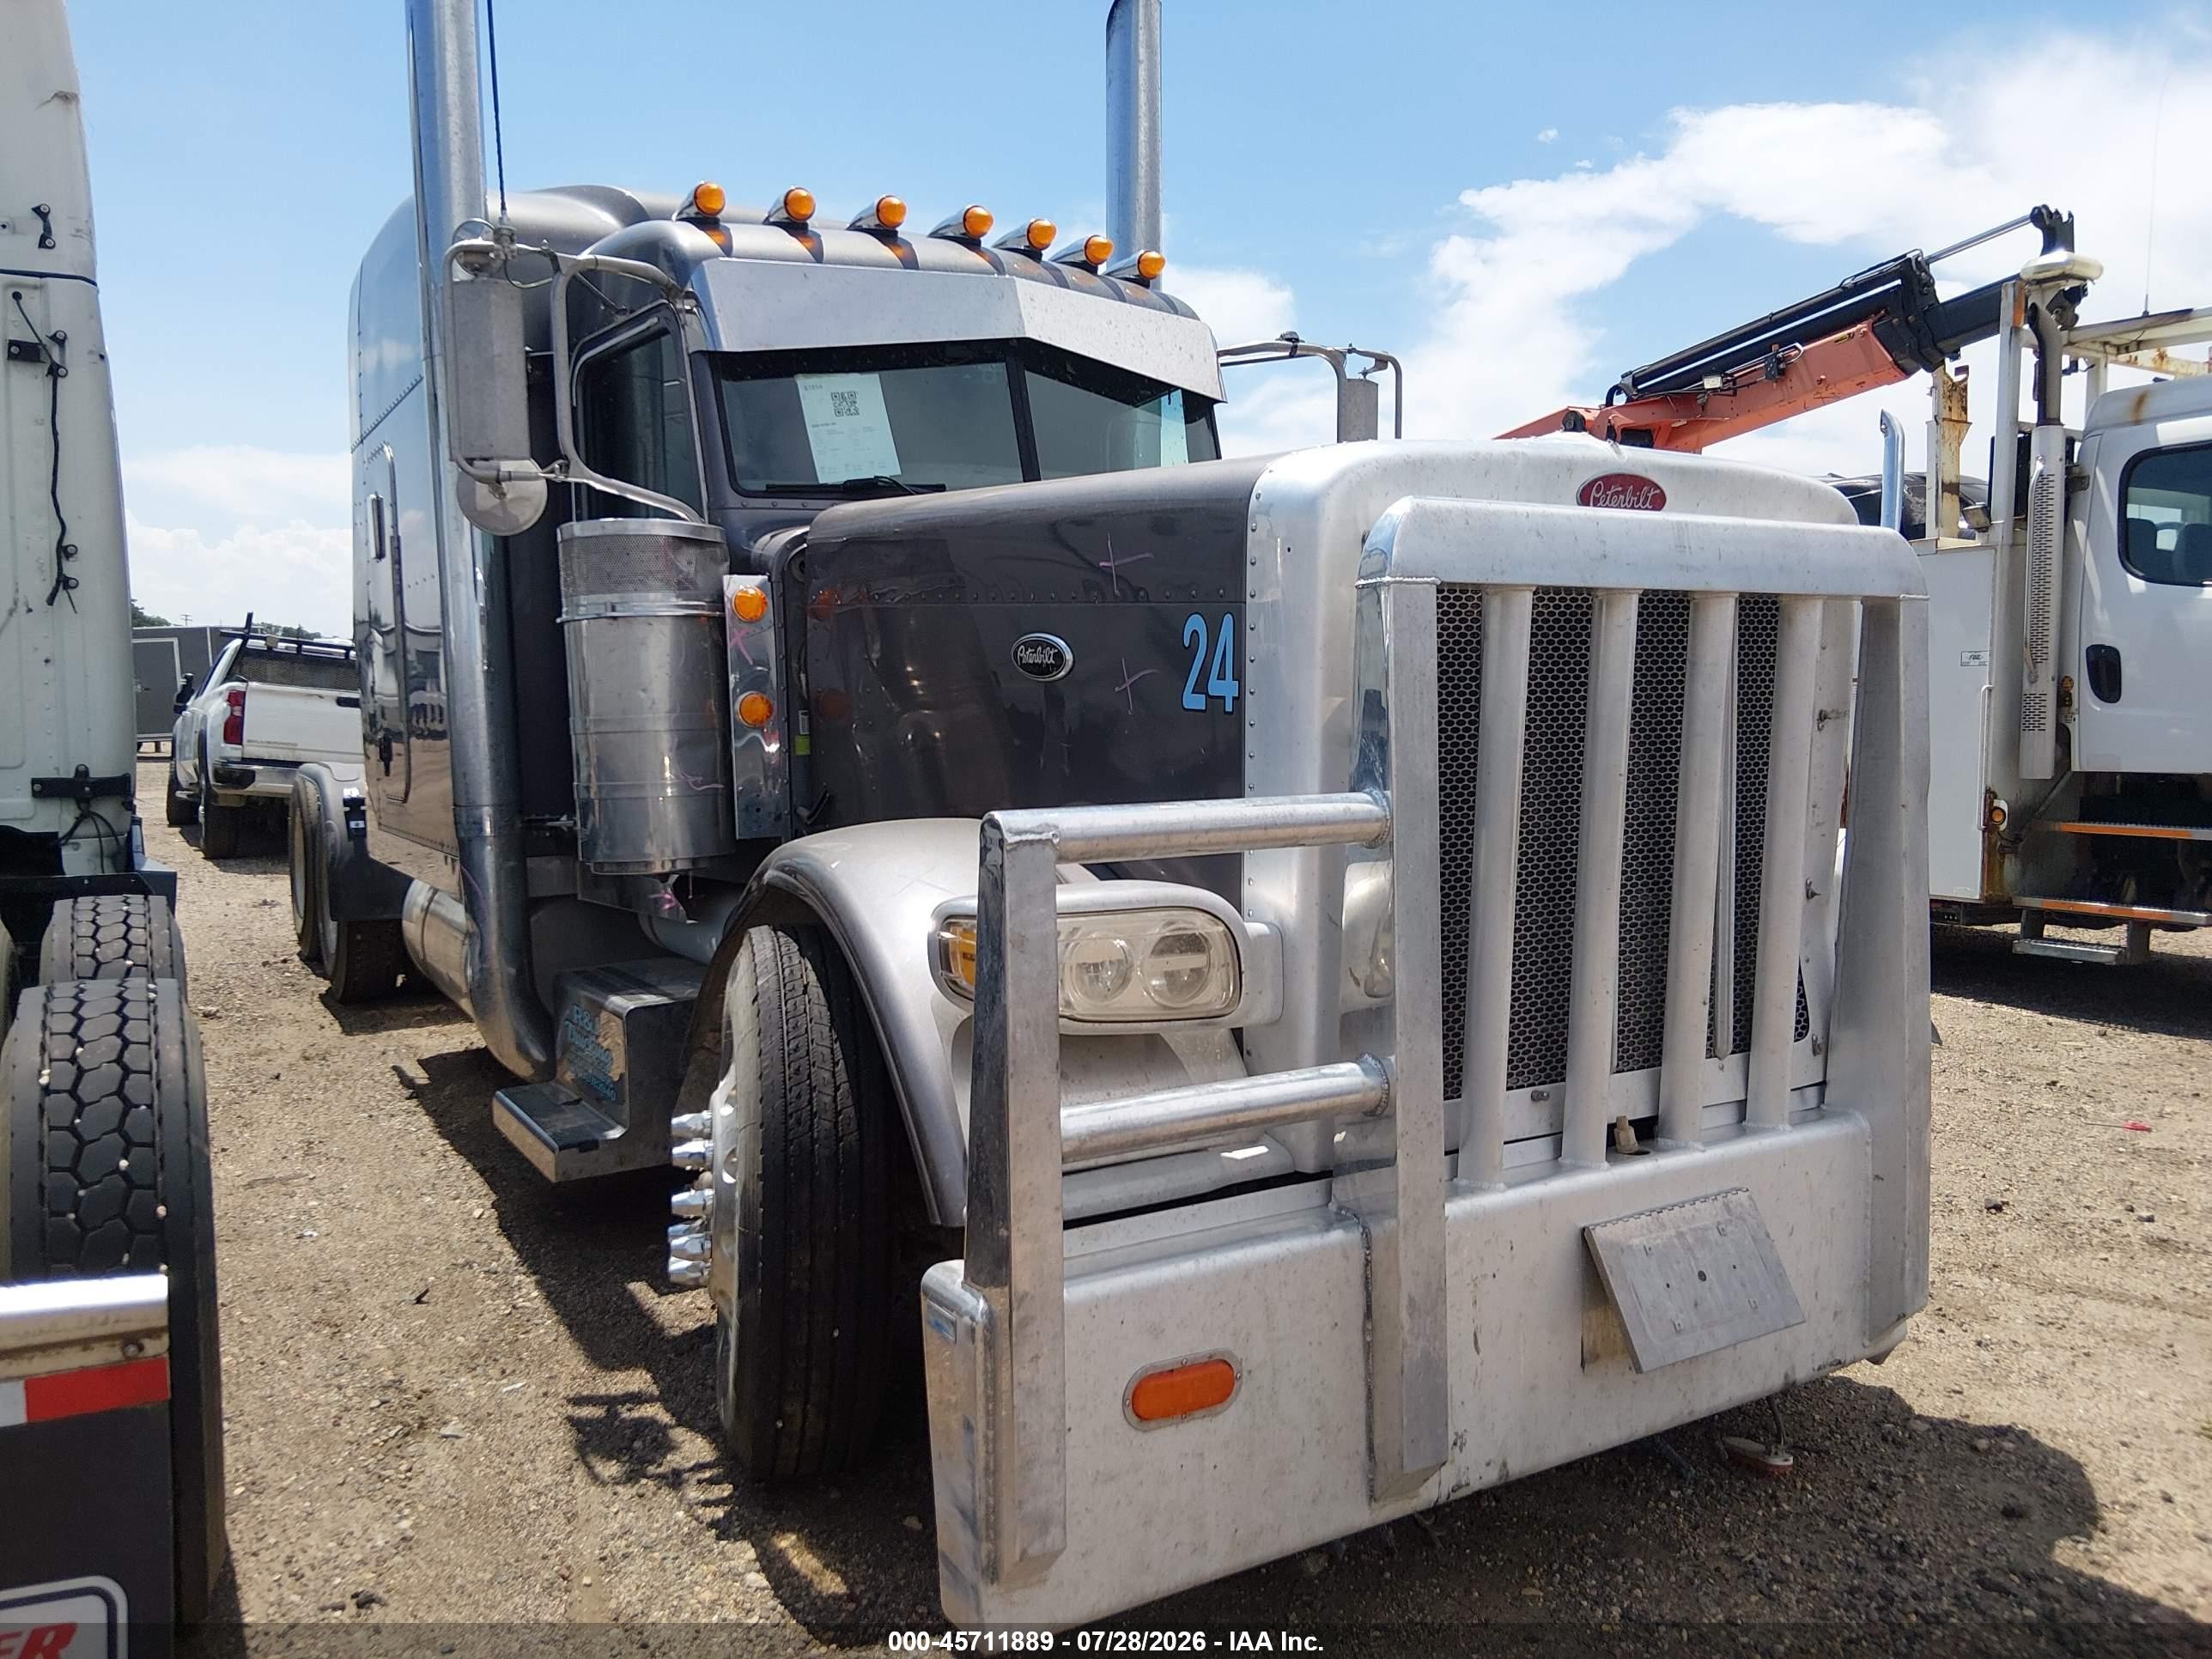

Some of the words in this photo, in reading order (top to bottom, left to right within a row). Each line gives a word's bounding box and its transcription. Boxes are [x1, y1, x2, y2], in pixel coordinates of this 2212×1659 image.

[1589, 480, 1661, 509] Peterbilt
[1017, 644, 1059, 666] Peterbilt
[1182, 611, 1240, 714] 24
